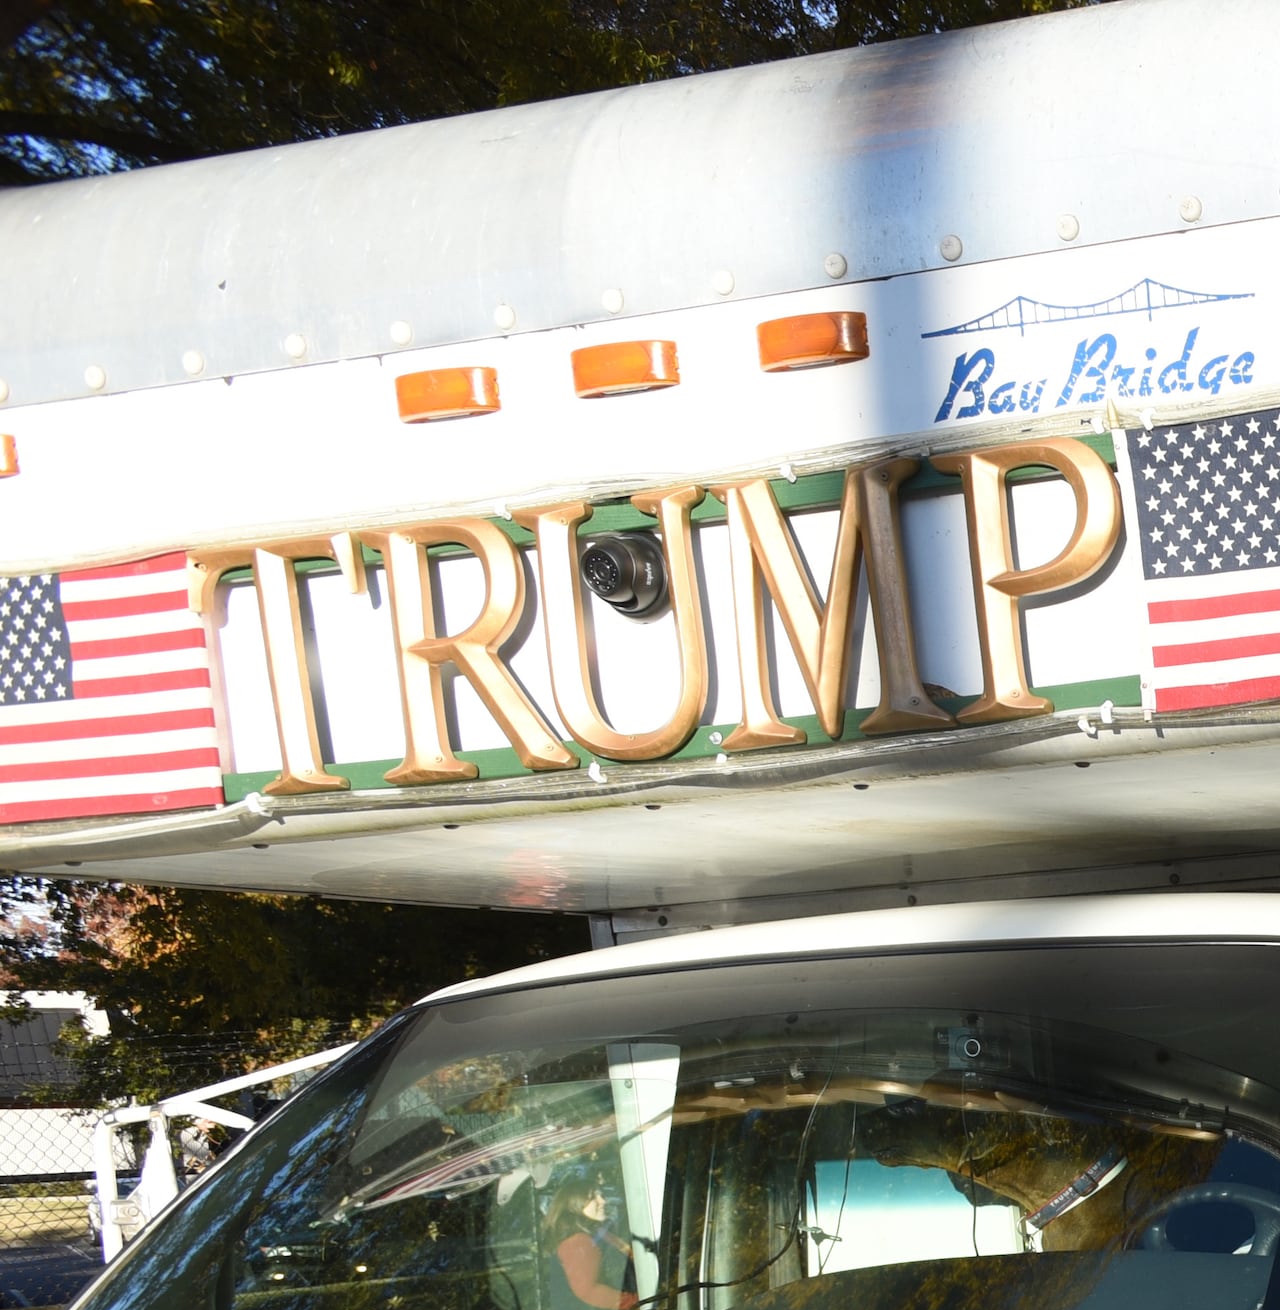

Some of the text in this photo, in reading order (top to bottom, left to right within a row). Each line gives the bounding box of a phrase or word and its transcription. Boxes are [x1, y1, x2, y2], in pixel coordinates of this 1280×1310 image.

[933, 326, 1256, 424] Bay Bridge
[186, 436, 1123, 796] TRUMP
